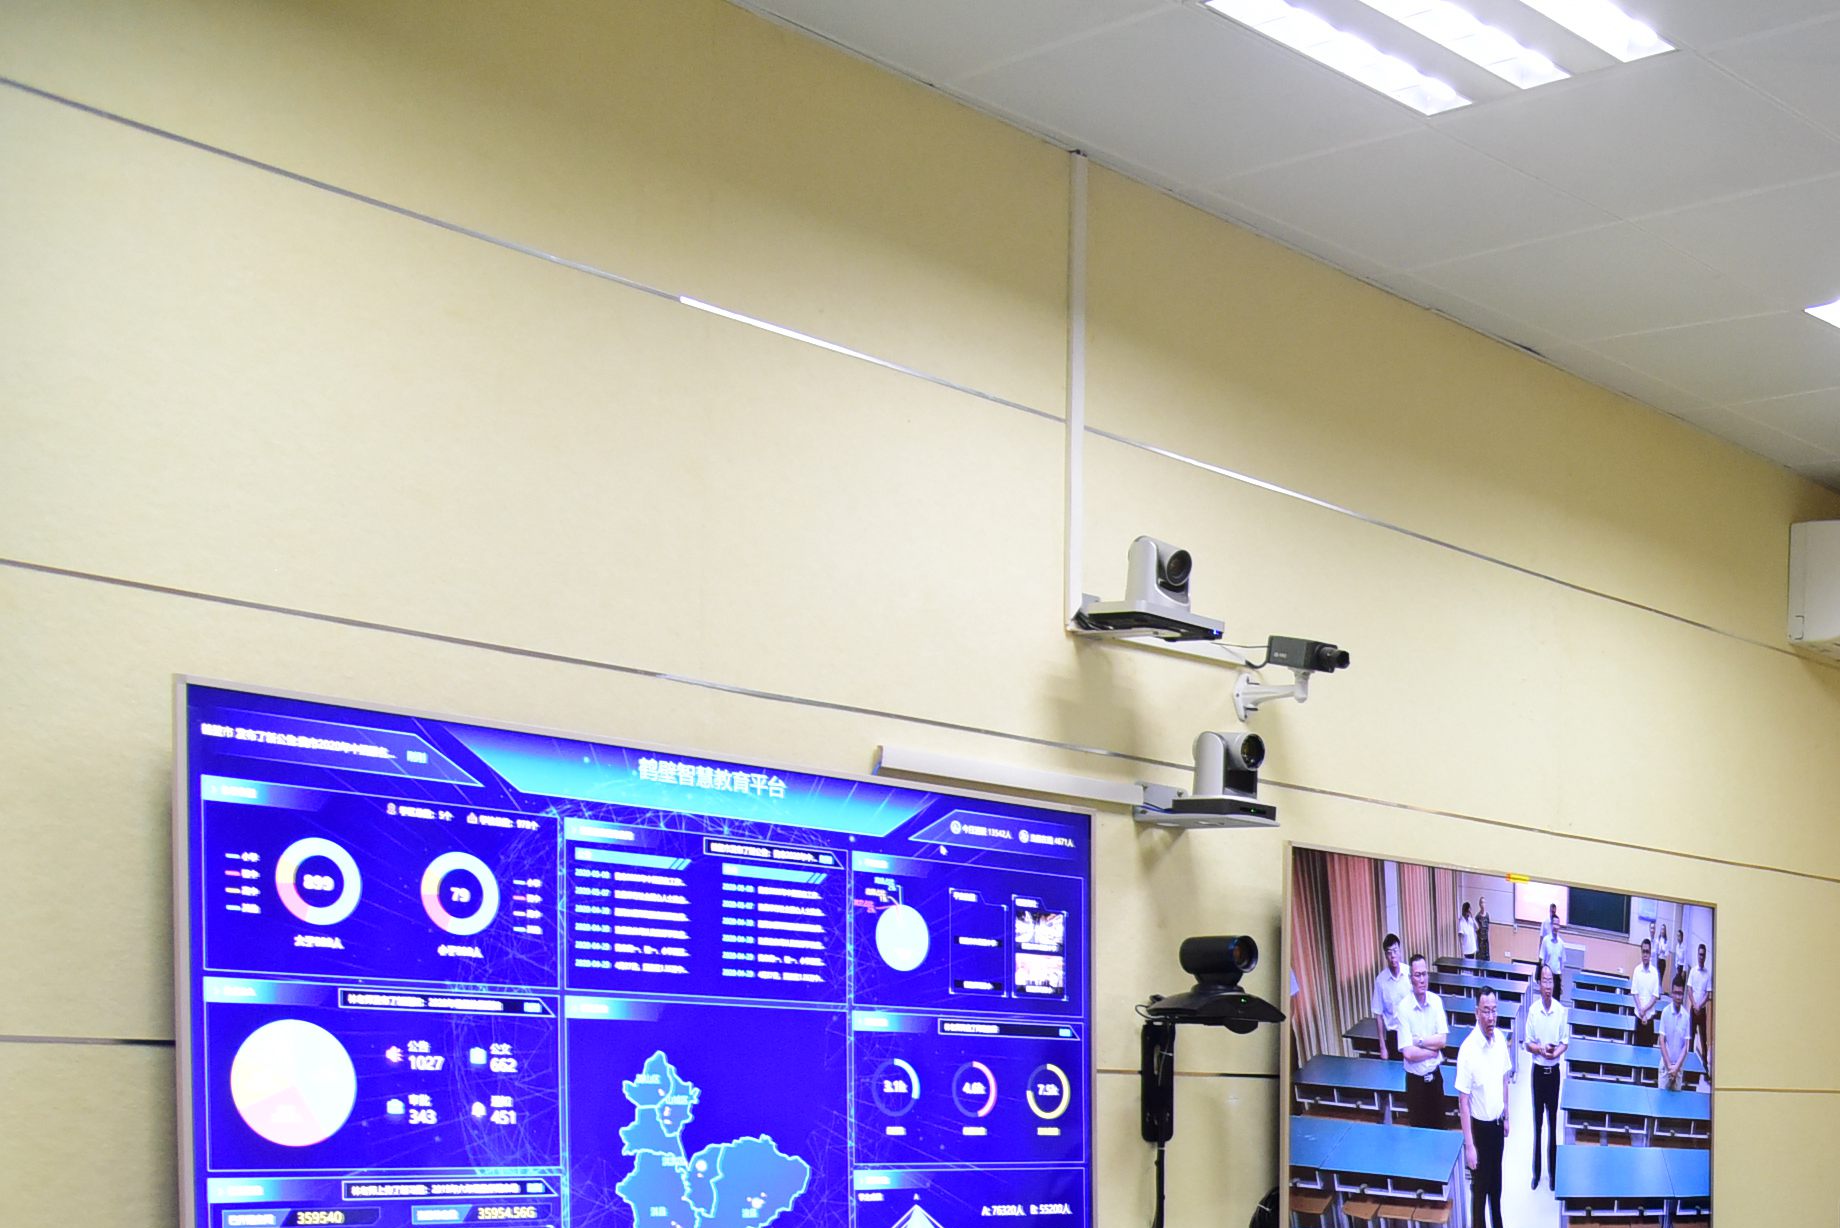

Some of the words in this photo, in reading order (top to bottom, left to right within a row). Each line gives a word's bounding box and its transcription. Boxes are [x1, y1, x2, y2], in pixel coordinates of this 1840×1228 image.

[638, 757, 787, 798] 鹤壁智慧教育平台
[451, 887, 470, 902] 79
[408, 1055, 444, 1070] 1027
[409, 1109, 437, 1124] 343
[490, 1110, 516, 1124] 451
